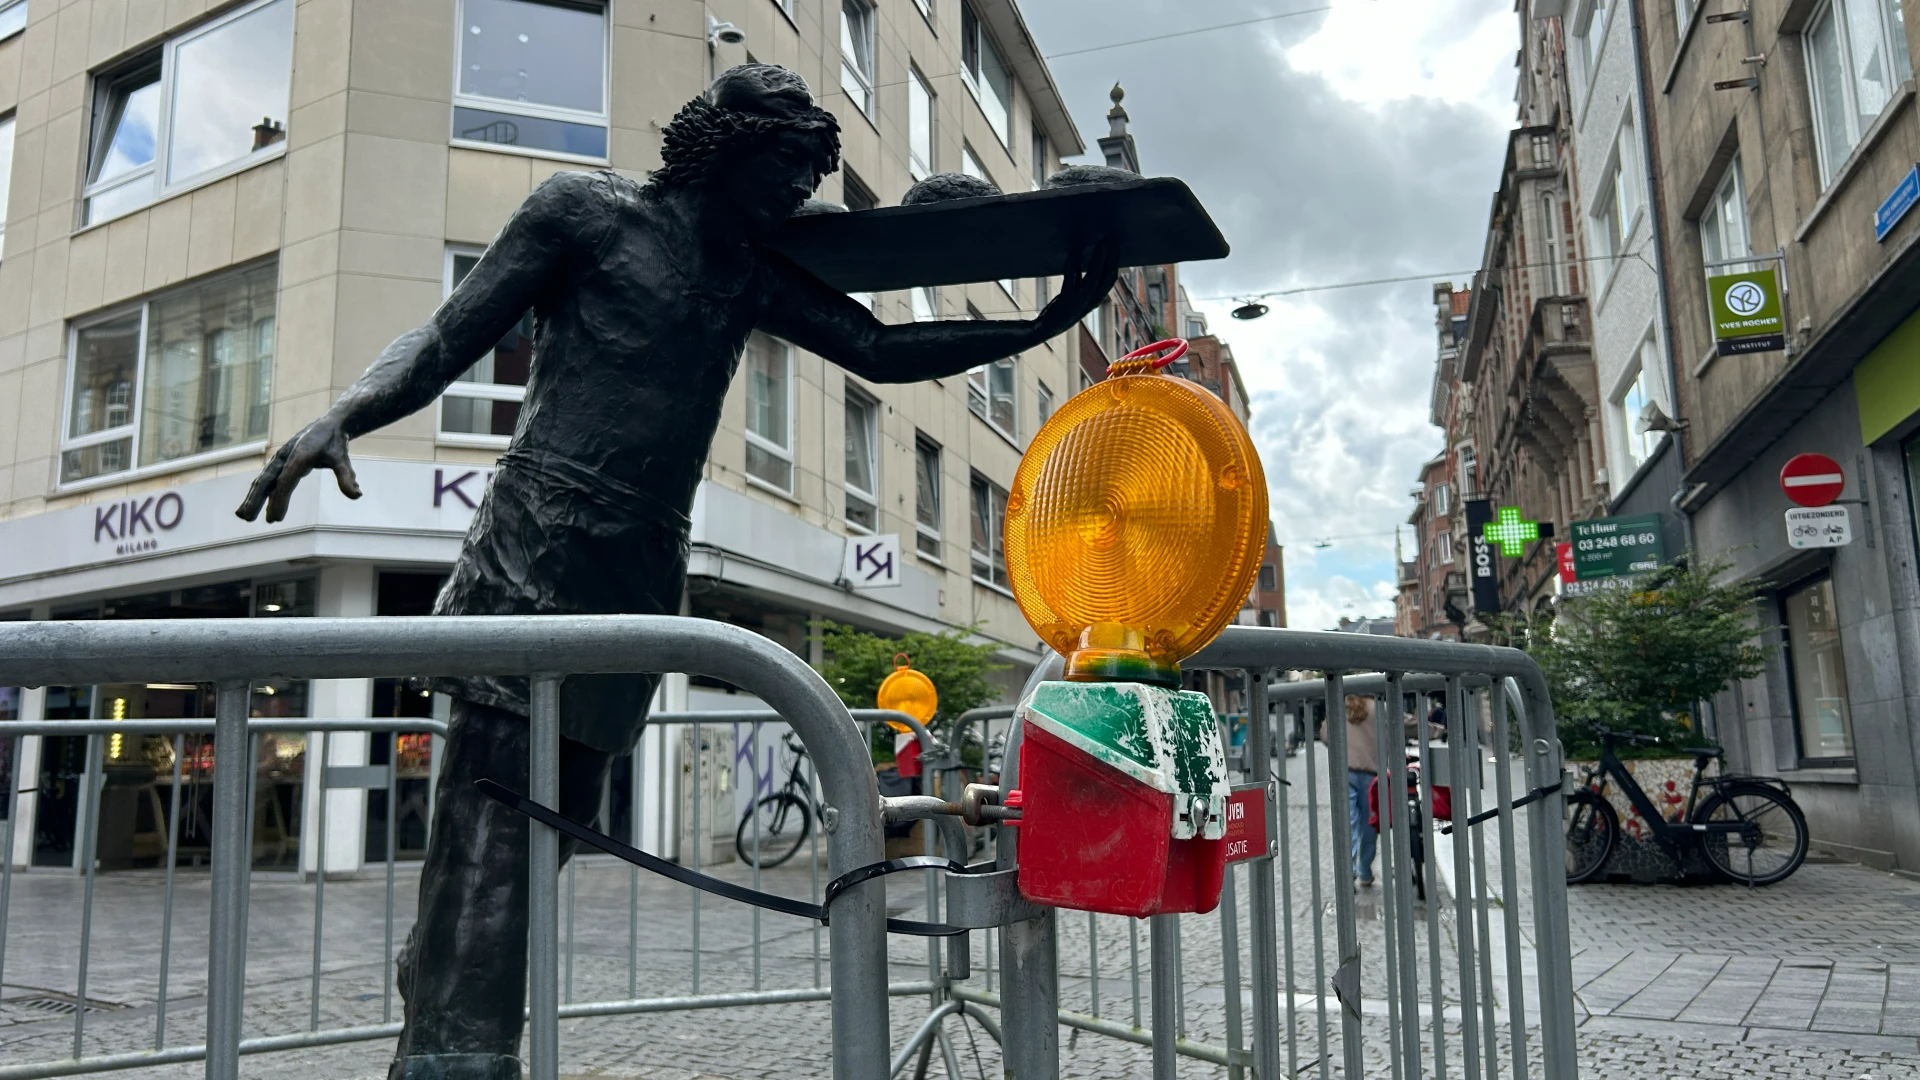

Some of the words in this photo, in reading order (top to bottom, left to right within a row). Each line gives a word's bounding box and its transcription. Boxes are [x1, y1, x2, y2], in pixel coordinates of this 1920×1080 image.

[1720, 321, 1741, 329] YVES
[1743, 317, 1778, 327] ROCHER
[1731, 341, 1772, 351] L'INSTITUT
[434, 468, 495, 508] K
[94, 491, 184, 543] KIKO
[1790, 510, 1845, 521] UITGEZONDERD
[1576, 525, 1590, 536] Te
[1591, 523, 1618, 534] Huur
[116, 538, 158, 555] MILANO
[1578, 539, 1593, 551] 03
[1595, 536, 1618, 549] 248
[1620, 534, 1636, 546] 68
[1638, 532, 1655, 544] 60
[1475, 534, 1491, 577] BOSS
[1567, 582, 1580, 593] 02
[1226, 840, 1248, 857] ISATIE
